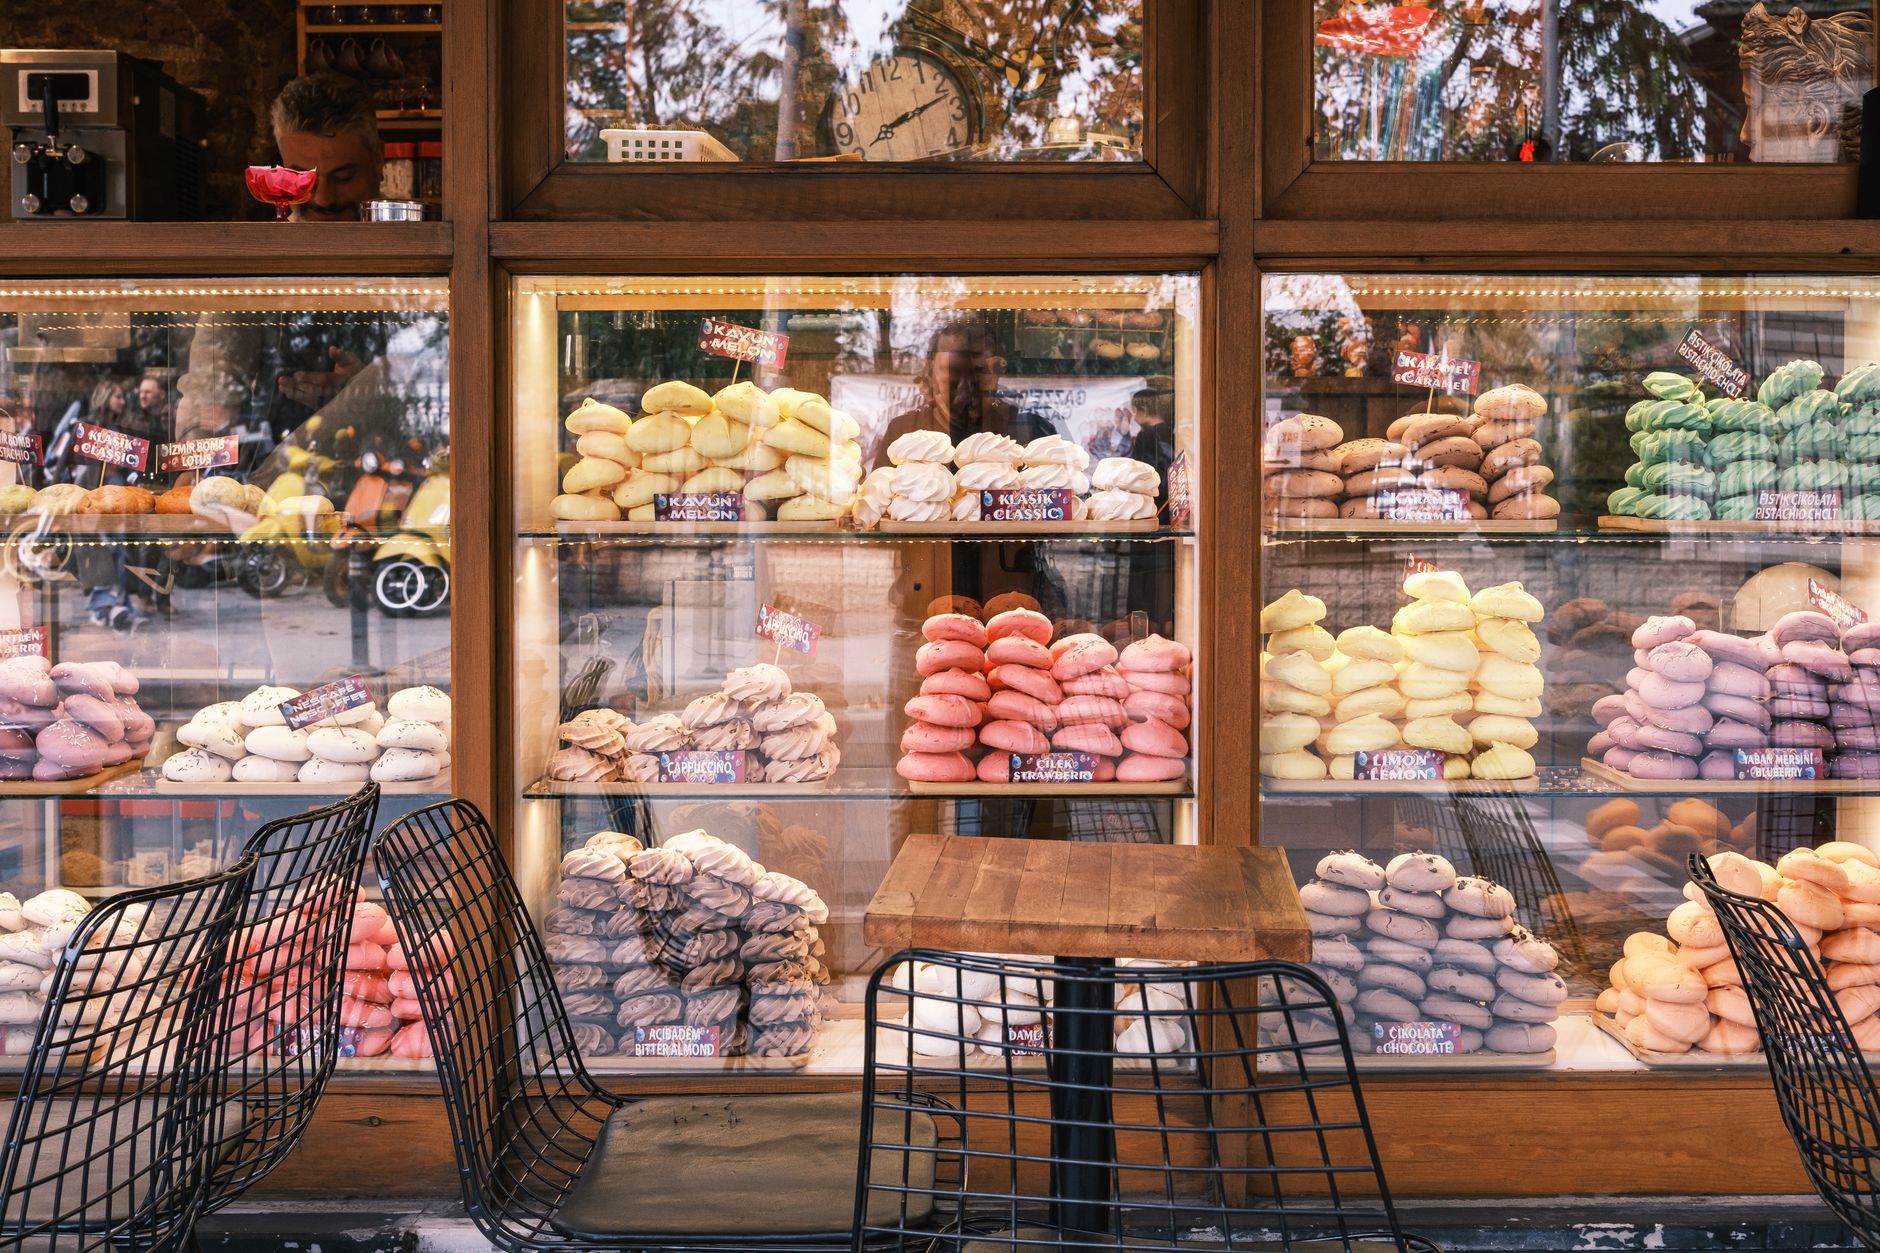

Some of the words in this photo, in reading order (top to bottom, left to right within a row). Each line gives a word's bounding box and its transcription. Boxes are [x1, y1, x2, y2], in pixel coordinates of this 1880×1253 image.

[877, 58, 902, 83] 12
[912, 57, 925, 84] 1
[932, 72, 950, 94] 2
[839, 92, 861, 117] 10
[949, 96, 965, 121] 3
[836, 122, 853, 146] 9
[945, 127, 961, 148] 4
[714, 325, 774, 346] KAVUN
[711, 338, 773, 360] MELON
[1405, 355, 1470, 376] KARAMEL
[1678, 343, 1718, 380] PISTACHIO
[1401, 371, 1470, 391] CARAMEL
[8, 435, 31, 448] BOMB
[169, 441, 195, 456] İZMİR
[196, 438, 225, 452] BOMB
[182, 453, 211, 467] LOTUS
[669, 497, 732, 507] KAVUN
[1759, 492, 1790, 506] FISTIK
[670, 510, 733, 520] MELON
[1755, 508, 1807, 520] PISTACHIO
[1743, 754, 1773, 765] YABAN
[1013, 771, 1095, 780] STRAWBERRY
[1370, 769, 1428, 780] LEMON
[1755, 767, 1802, 778] BLUBERRY
[649, 1028, 701, 1041] ACIBADEM
[1389, 1025, 1444, 1041] ÇİKOLATA
[670, 1043, 715, 1056] ALMOND
[1383, 1042, 1452, 1054] CHOCOLATE
